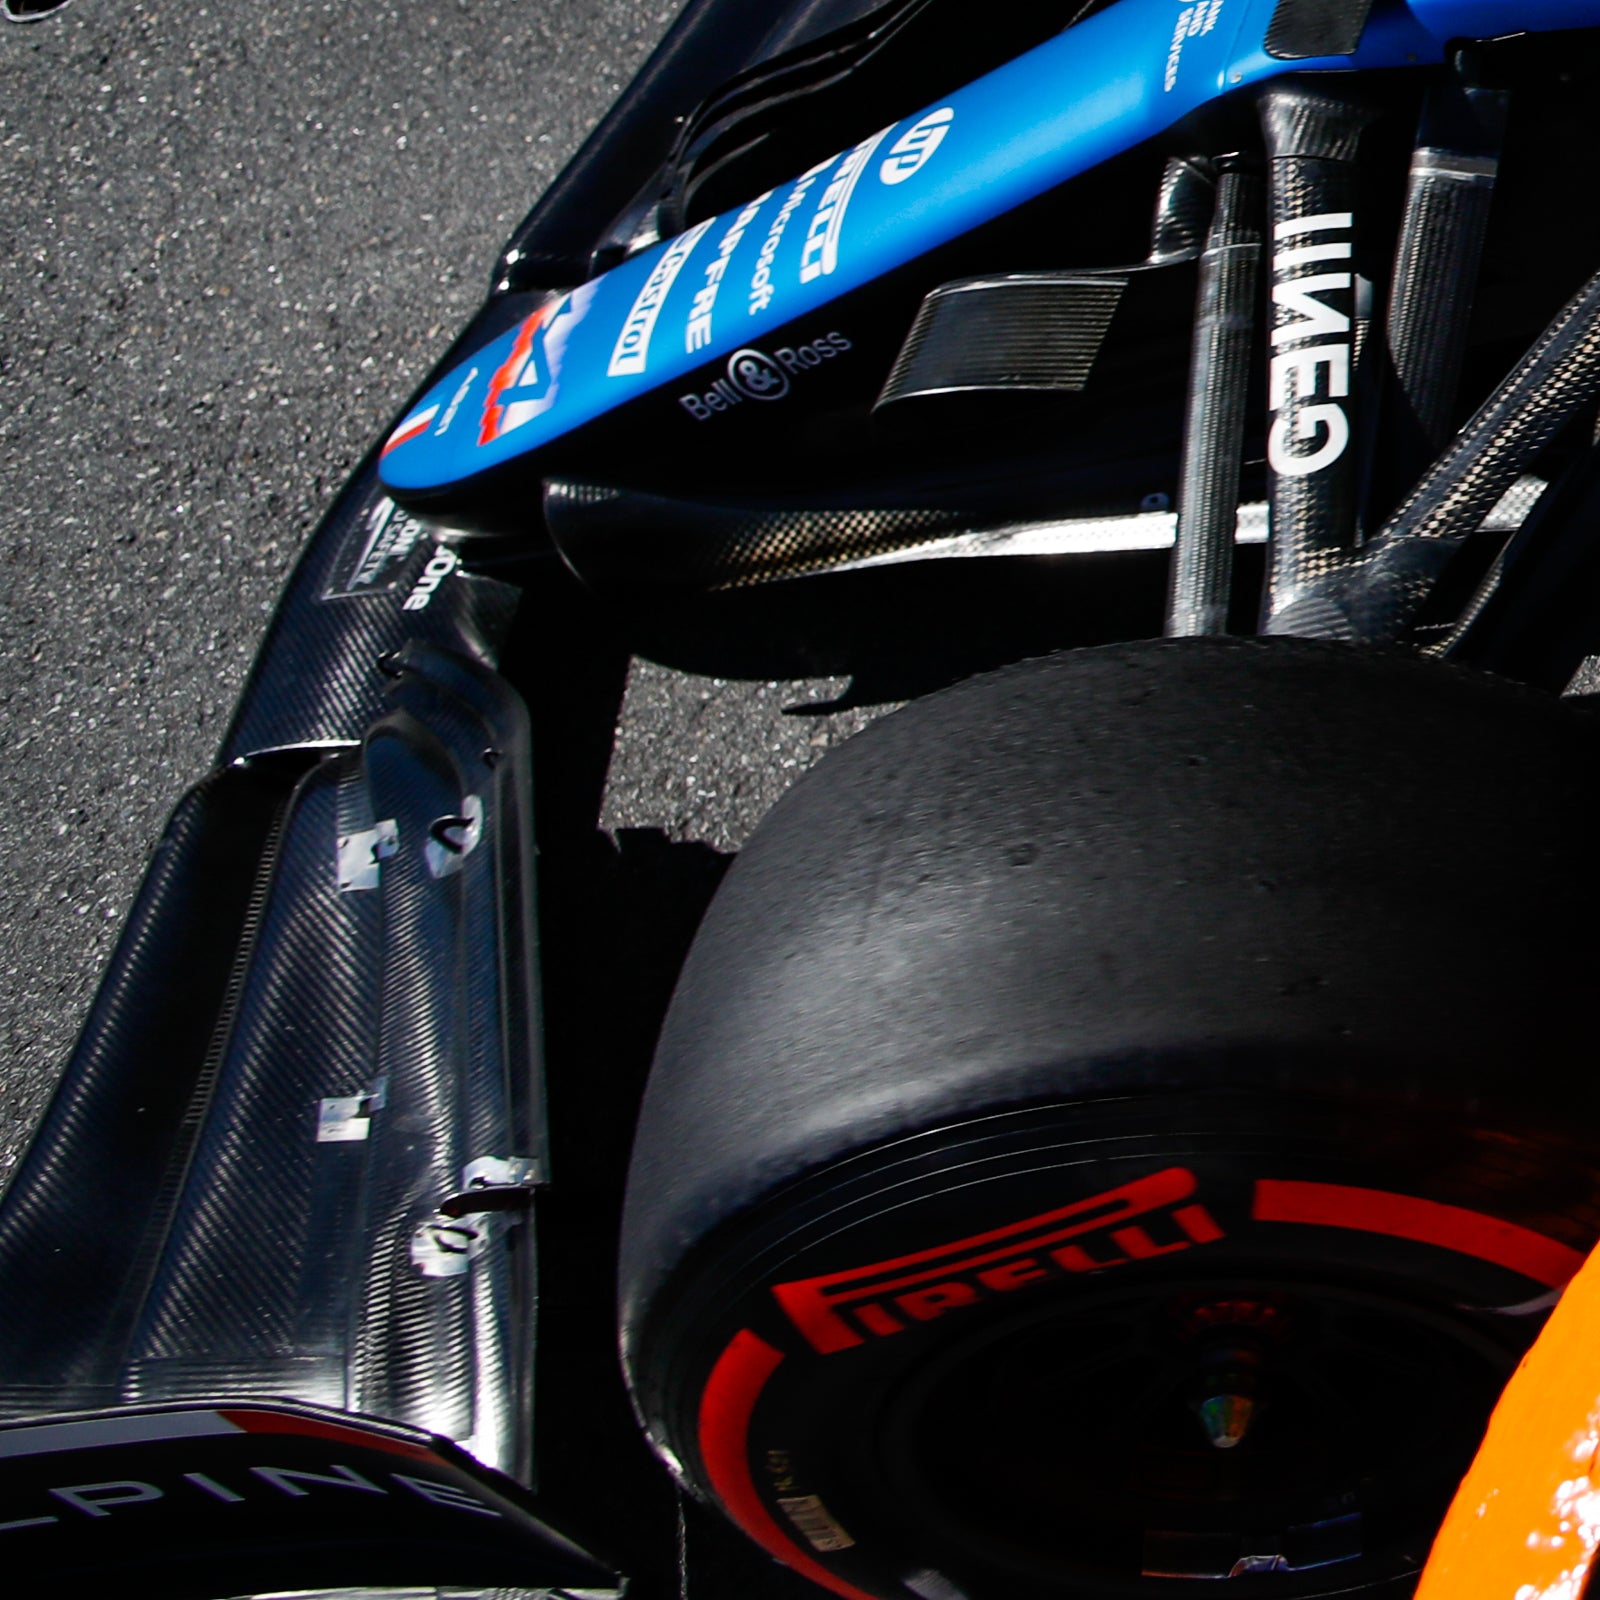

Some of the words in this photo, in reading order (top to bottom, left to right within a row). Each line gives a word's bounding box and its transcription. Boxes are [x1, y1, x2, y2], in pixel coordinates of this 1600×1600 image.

[1164, 6, 1194, 92] SERVICES
[1187, 0, 1210, 38] AND
[748, 176, 816, 316] Microsoft
[800, 121, 900, 284] IRELLI
[616, 248, 684, 366] Castrol
[679, 379, 742, 422] Bell
[775, 330, 852, 376] Ross
[770, 1166, 1225, 1355] PIRELLI
